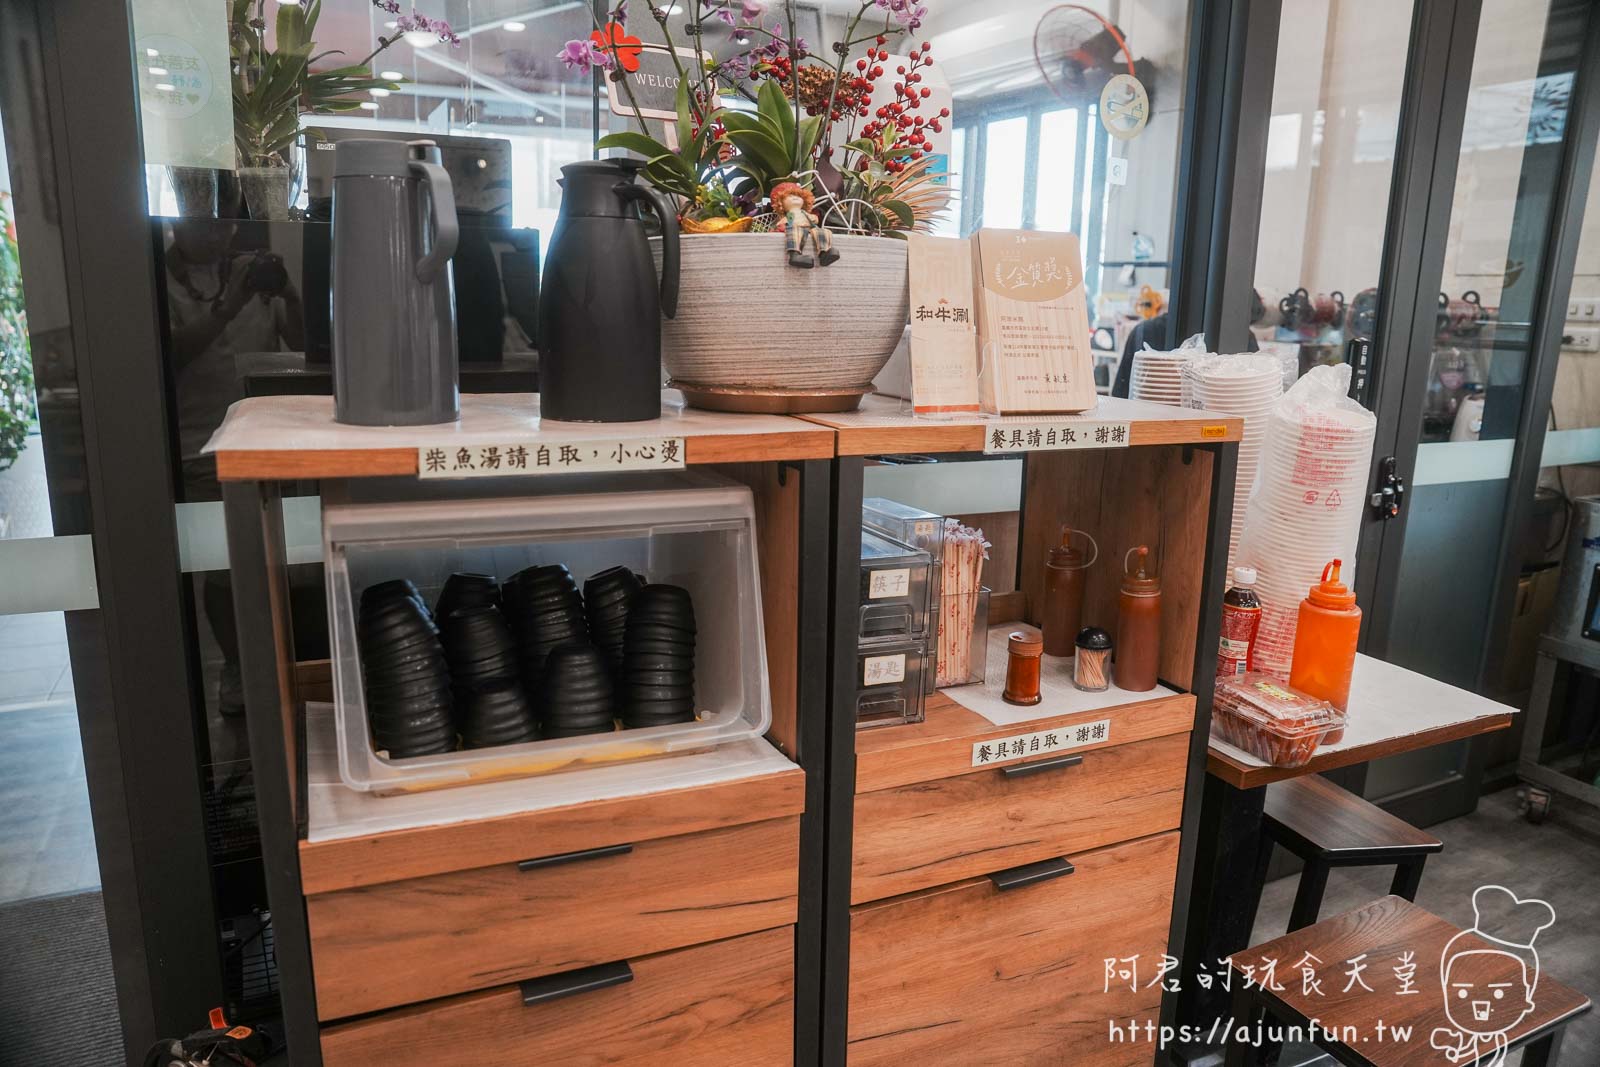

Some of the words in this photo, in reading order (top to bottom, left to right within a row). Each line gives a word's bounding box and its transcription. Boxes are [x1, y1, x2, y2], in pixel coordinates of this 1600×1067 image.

[1006, 256, 1062, 289] 金質獎
[915, 305, 969, 323] 和牛涮
[990, 425, 1126, 449] 餐具請自取，謝謝
[425, 440, 680, 472] 柴魚湯請自取，小心燙
[872, 574, 906, 593] 筷子
[867, 661, 900, 680] 湯匙
[976, 723, 1106, 763] 餐具請自取，謝謝
